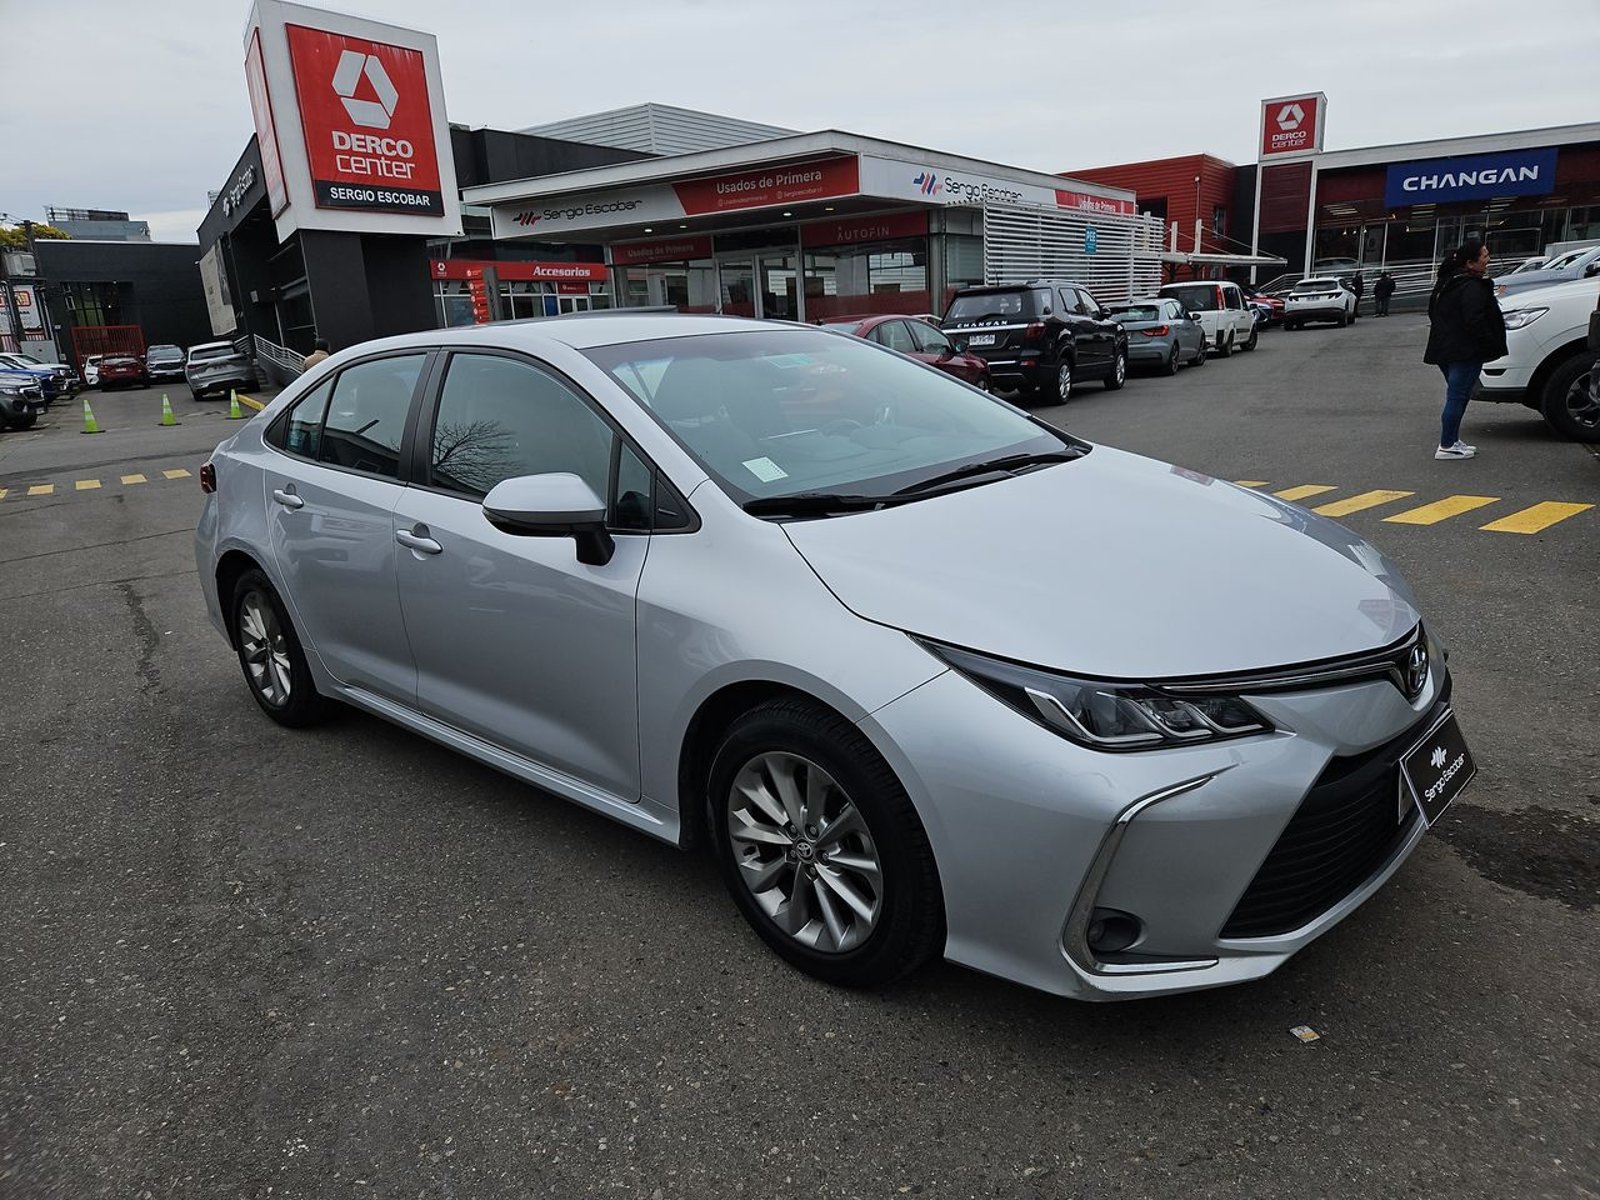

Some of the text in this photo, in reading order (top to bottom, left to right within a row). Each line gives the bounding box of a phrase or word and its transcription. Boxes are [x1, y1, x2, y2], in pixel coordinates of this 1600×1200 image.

[331, 130, 414, 159] DERCO
[1272, 131, 1307, 142] DERCO
[335, 154, 416, 180] center
[716, 170, 822, 194] Usados de Primera
[1403, 165, 1539, 191] CHANGAN
[330, 187, 430, 206] SERGIO ESCOBAR
[585, 200, 642, 214] Escobar
[532, 265, 591, 277] Accesorios
